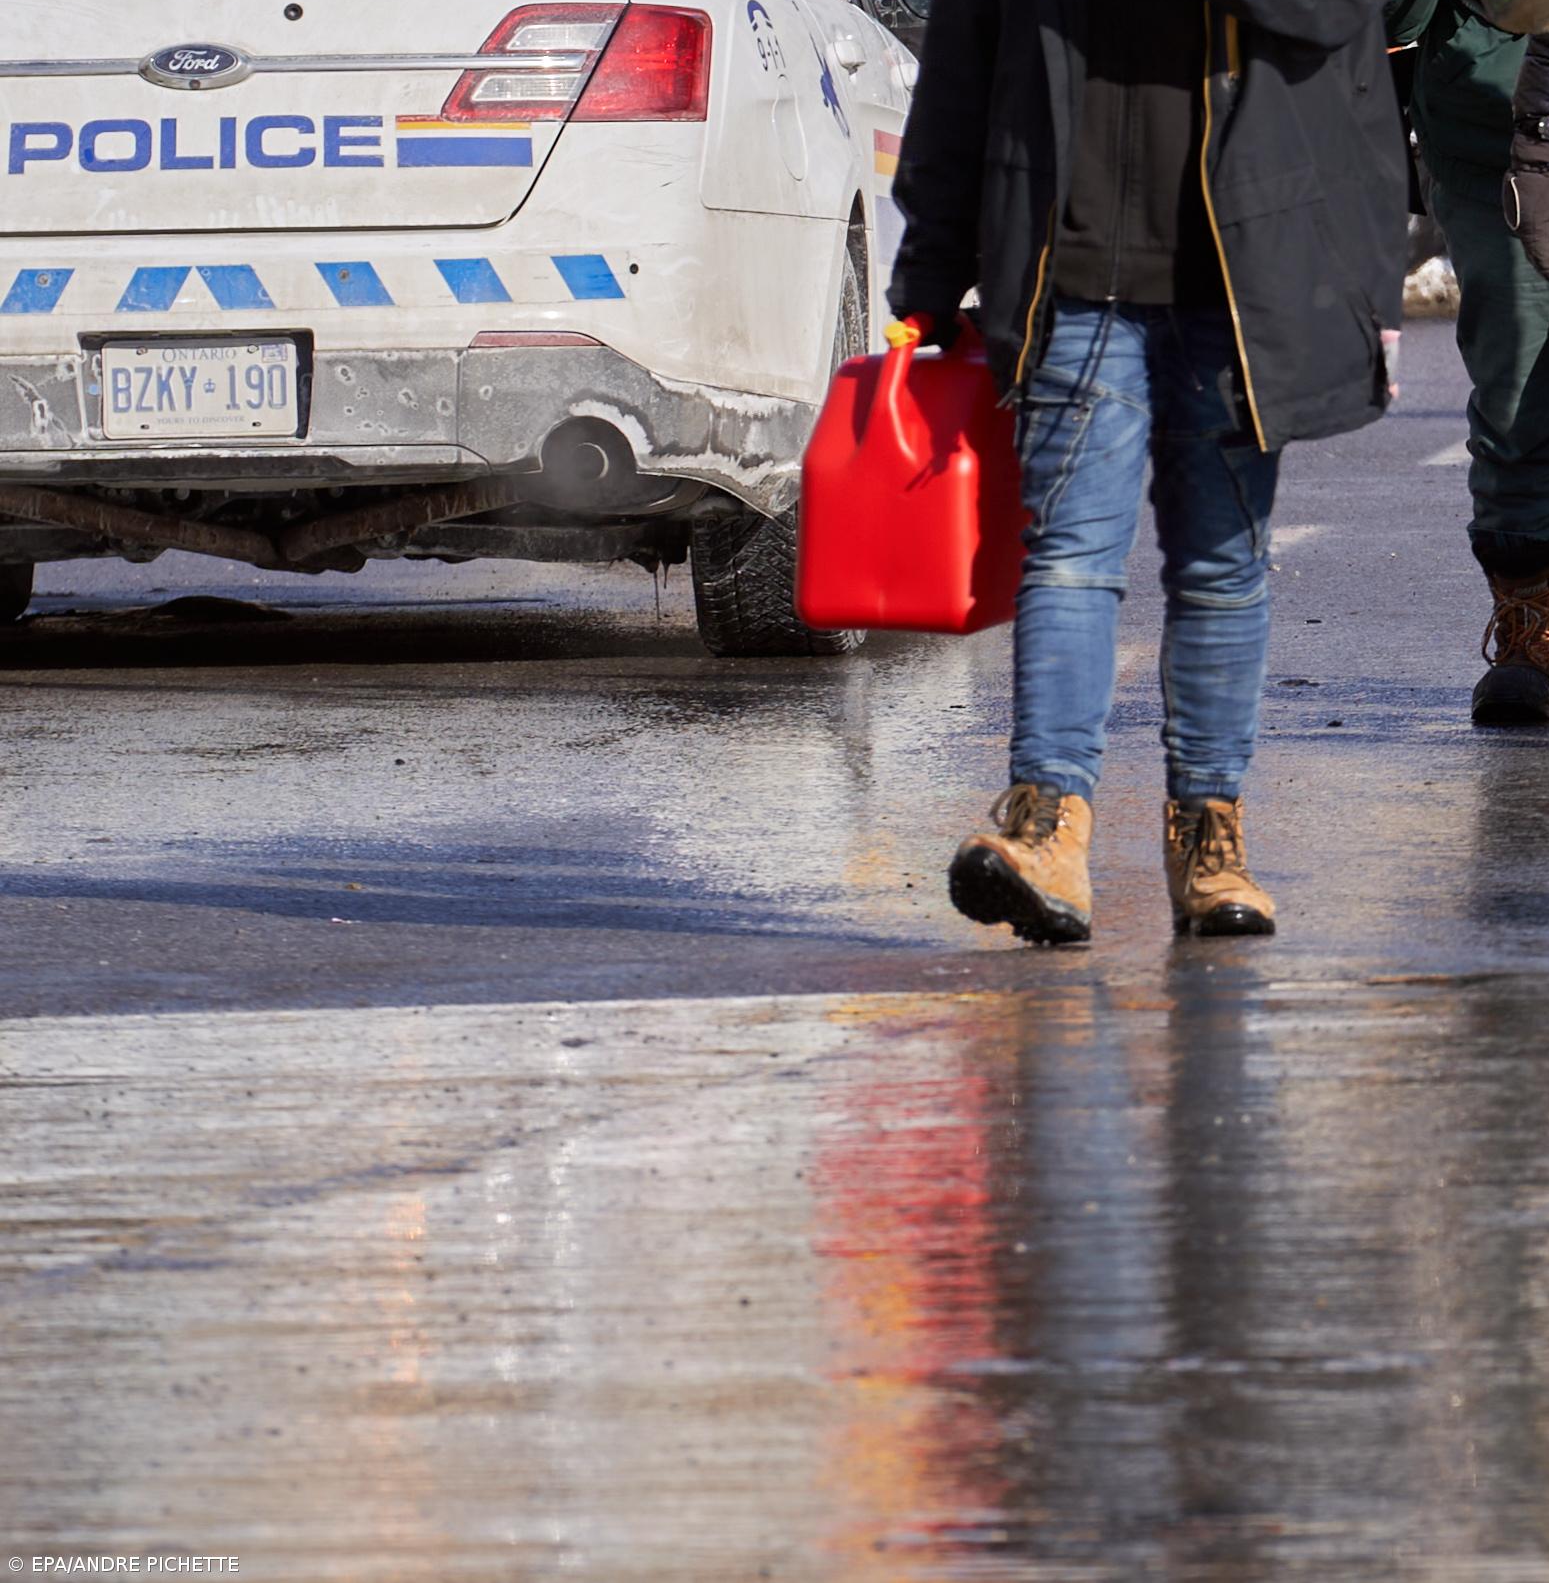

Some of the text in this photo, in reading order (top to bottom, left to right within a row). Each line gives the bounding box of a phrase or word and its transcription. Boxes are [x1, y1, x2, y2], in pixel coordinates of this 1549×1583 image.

[168, 49, 220, 71] Ford
[8, 115, 385, 175] POLICE
[111, 364, 288, 413] BZKY 190
